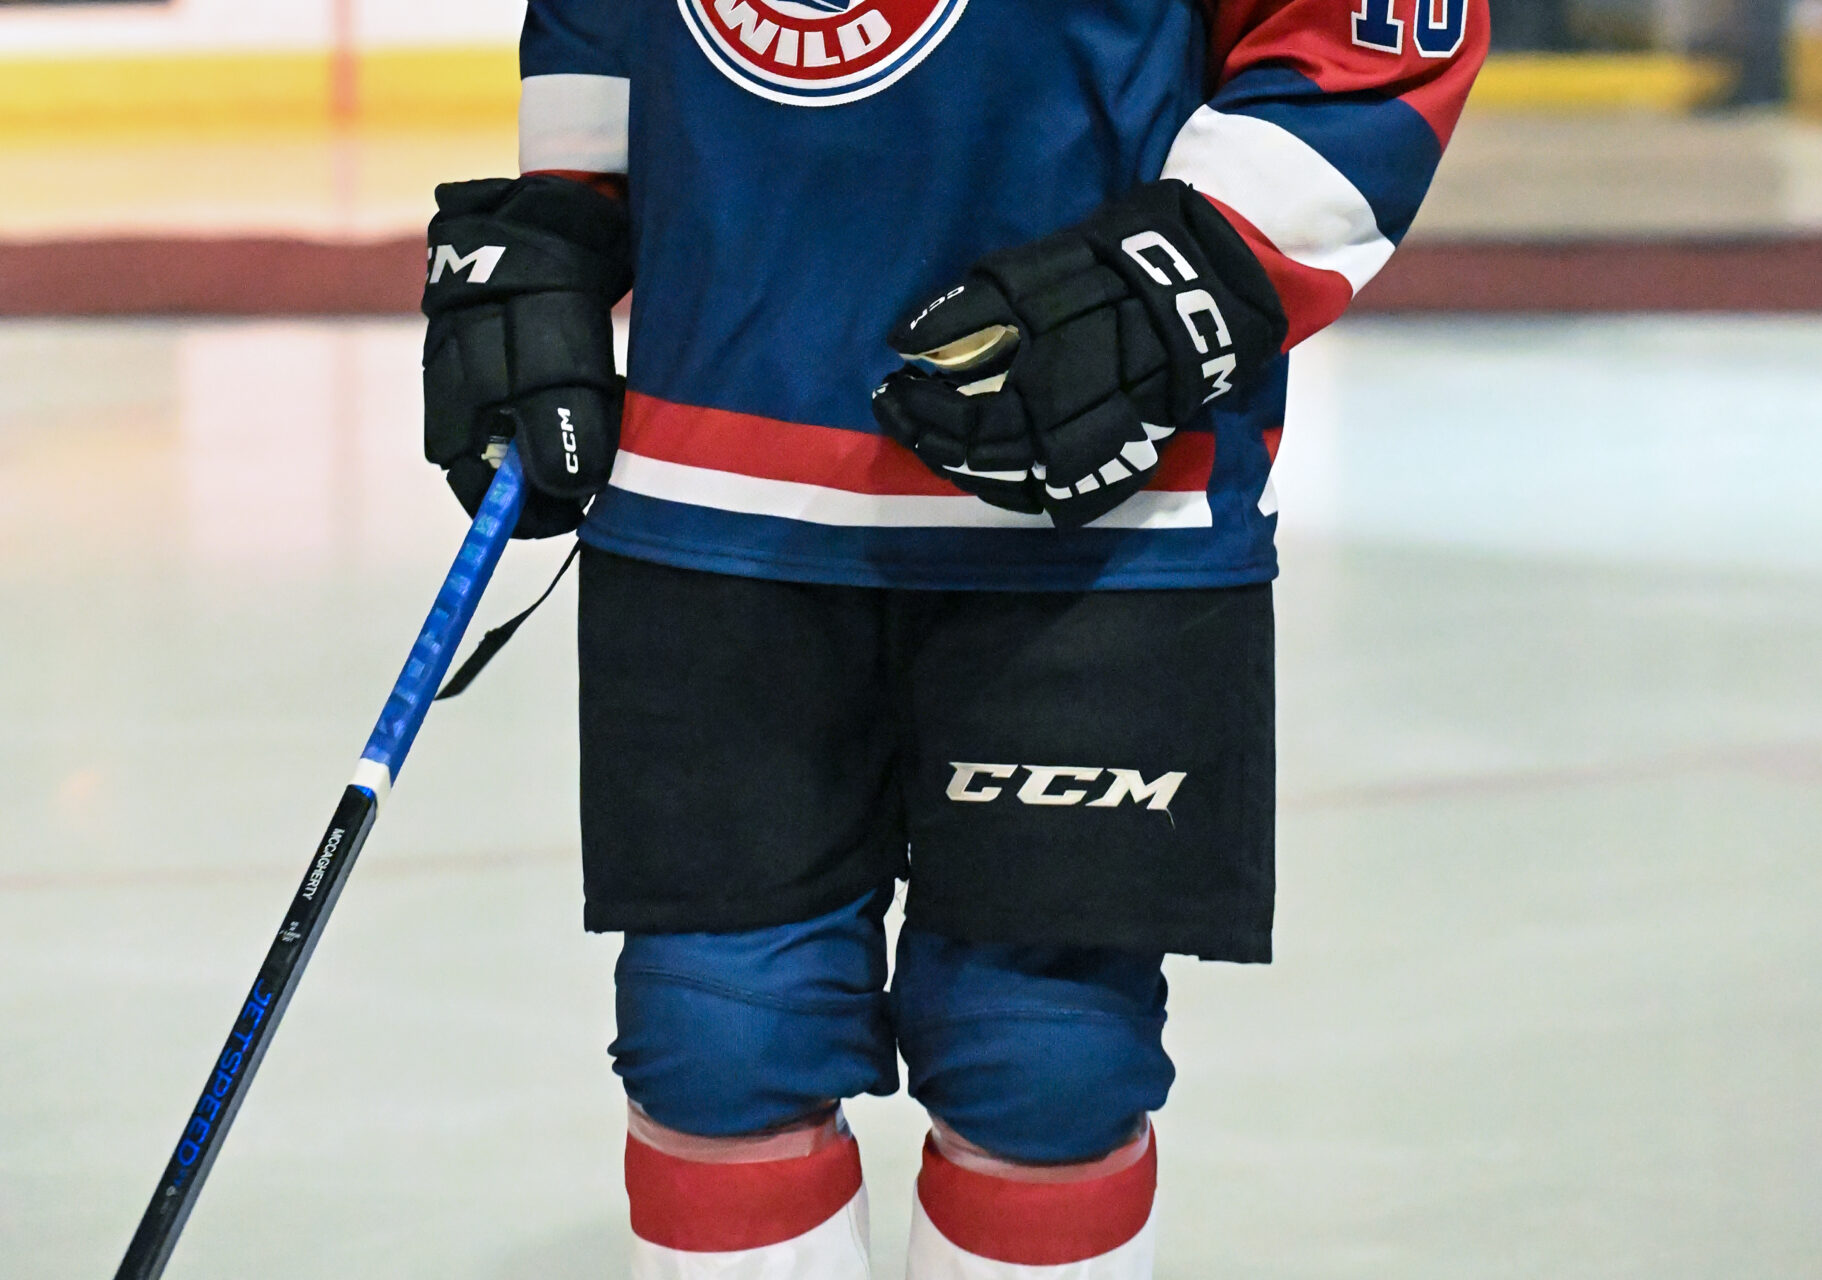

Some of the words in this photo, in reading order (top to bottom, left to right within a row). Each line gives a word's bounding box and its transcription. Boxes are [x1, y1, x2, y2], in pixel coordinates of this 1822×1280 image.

[1121, 230, 1236, 405] CCM
[557, 407, 579, 474] CCM
[945, 761, 1187, 811] CCM
[302, 827, 346, 901] MCCAGHERTY
[177, 978, 272, 1167] JETSPEED
